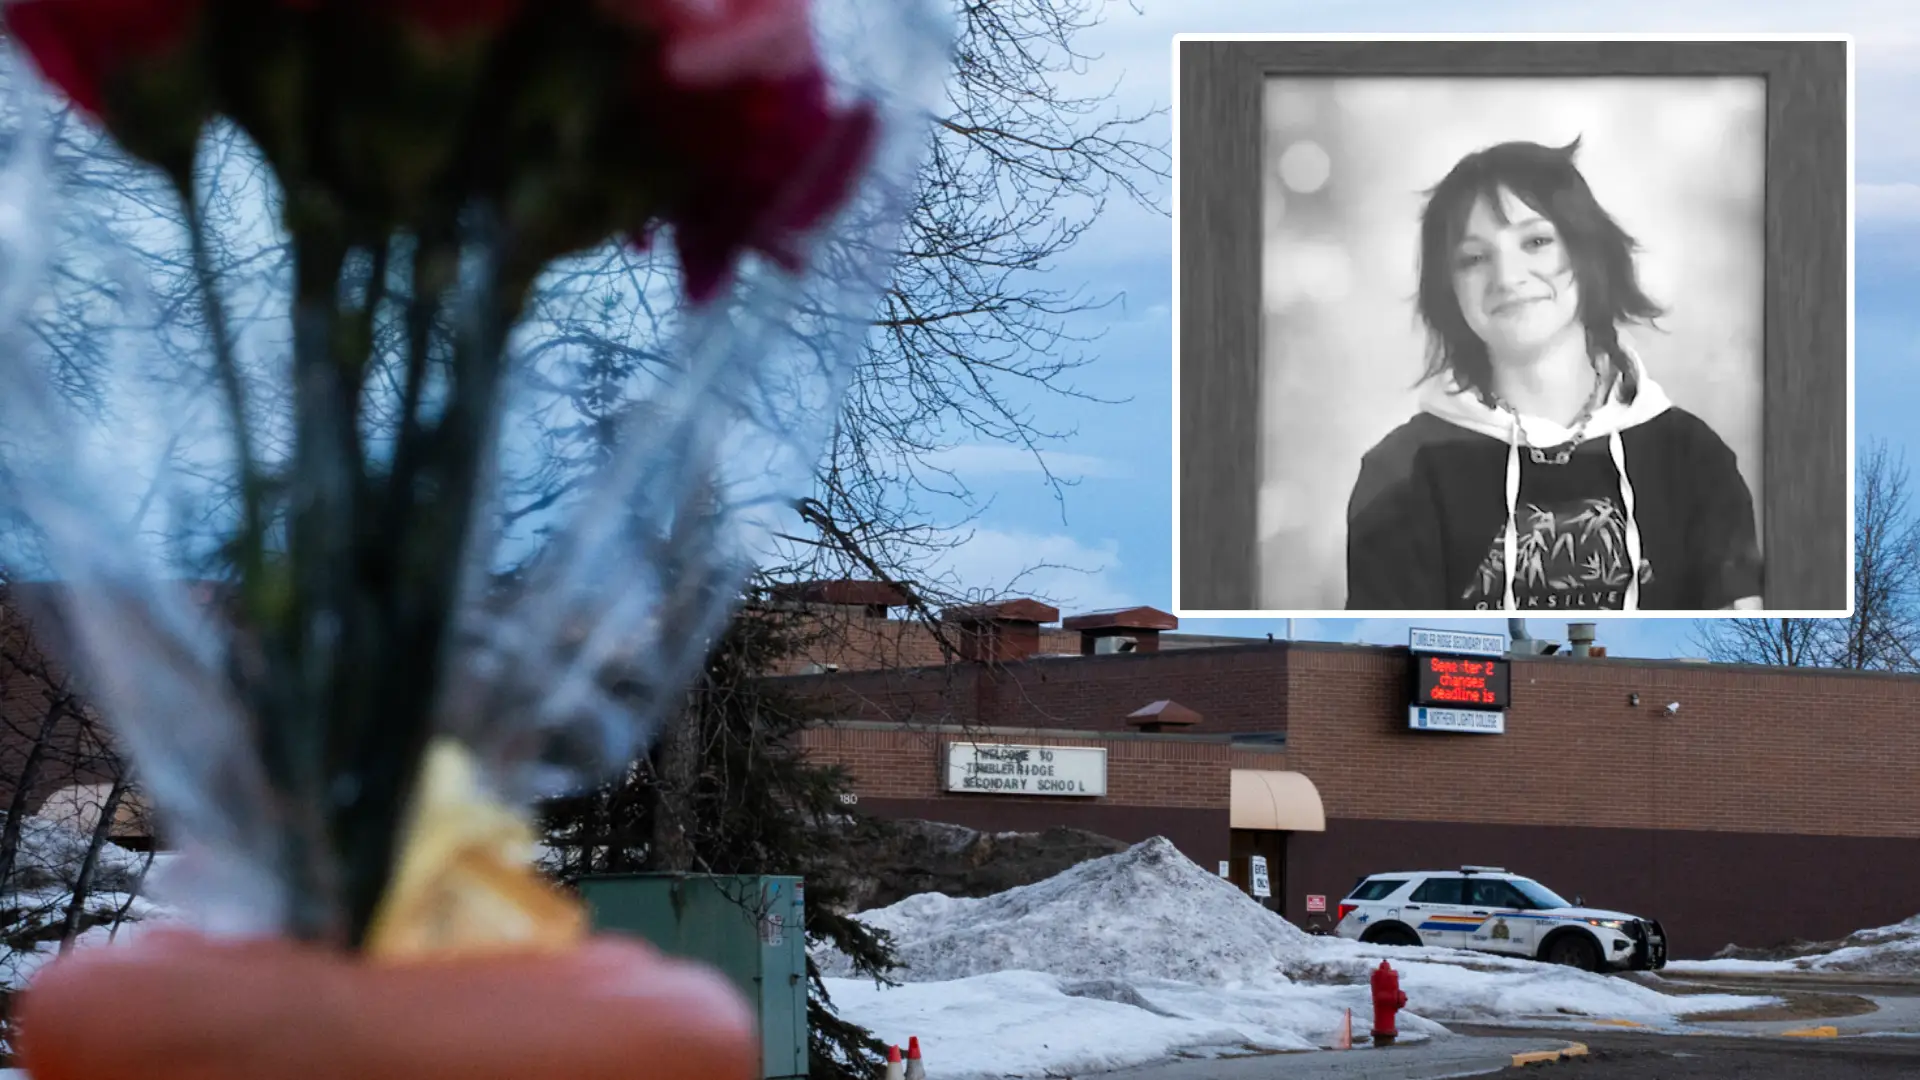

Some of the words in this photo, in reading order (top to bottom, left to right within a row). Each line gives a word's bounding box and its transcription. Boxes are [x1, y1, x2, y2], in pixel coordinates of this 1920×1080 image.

[1475, 591, 1617, 610] QUIKSILVE
[1485, 661, 1494, 675] 2
[1430, 685, 1480, 702] deadline
[1482, 689, 1495, 703] is
[980, 749, 1029, 762] WELCOME
[963, 777, 1028, 790] SECONDARY
[1037, 779, 1086, 792] SCHOOL
